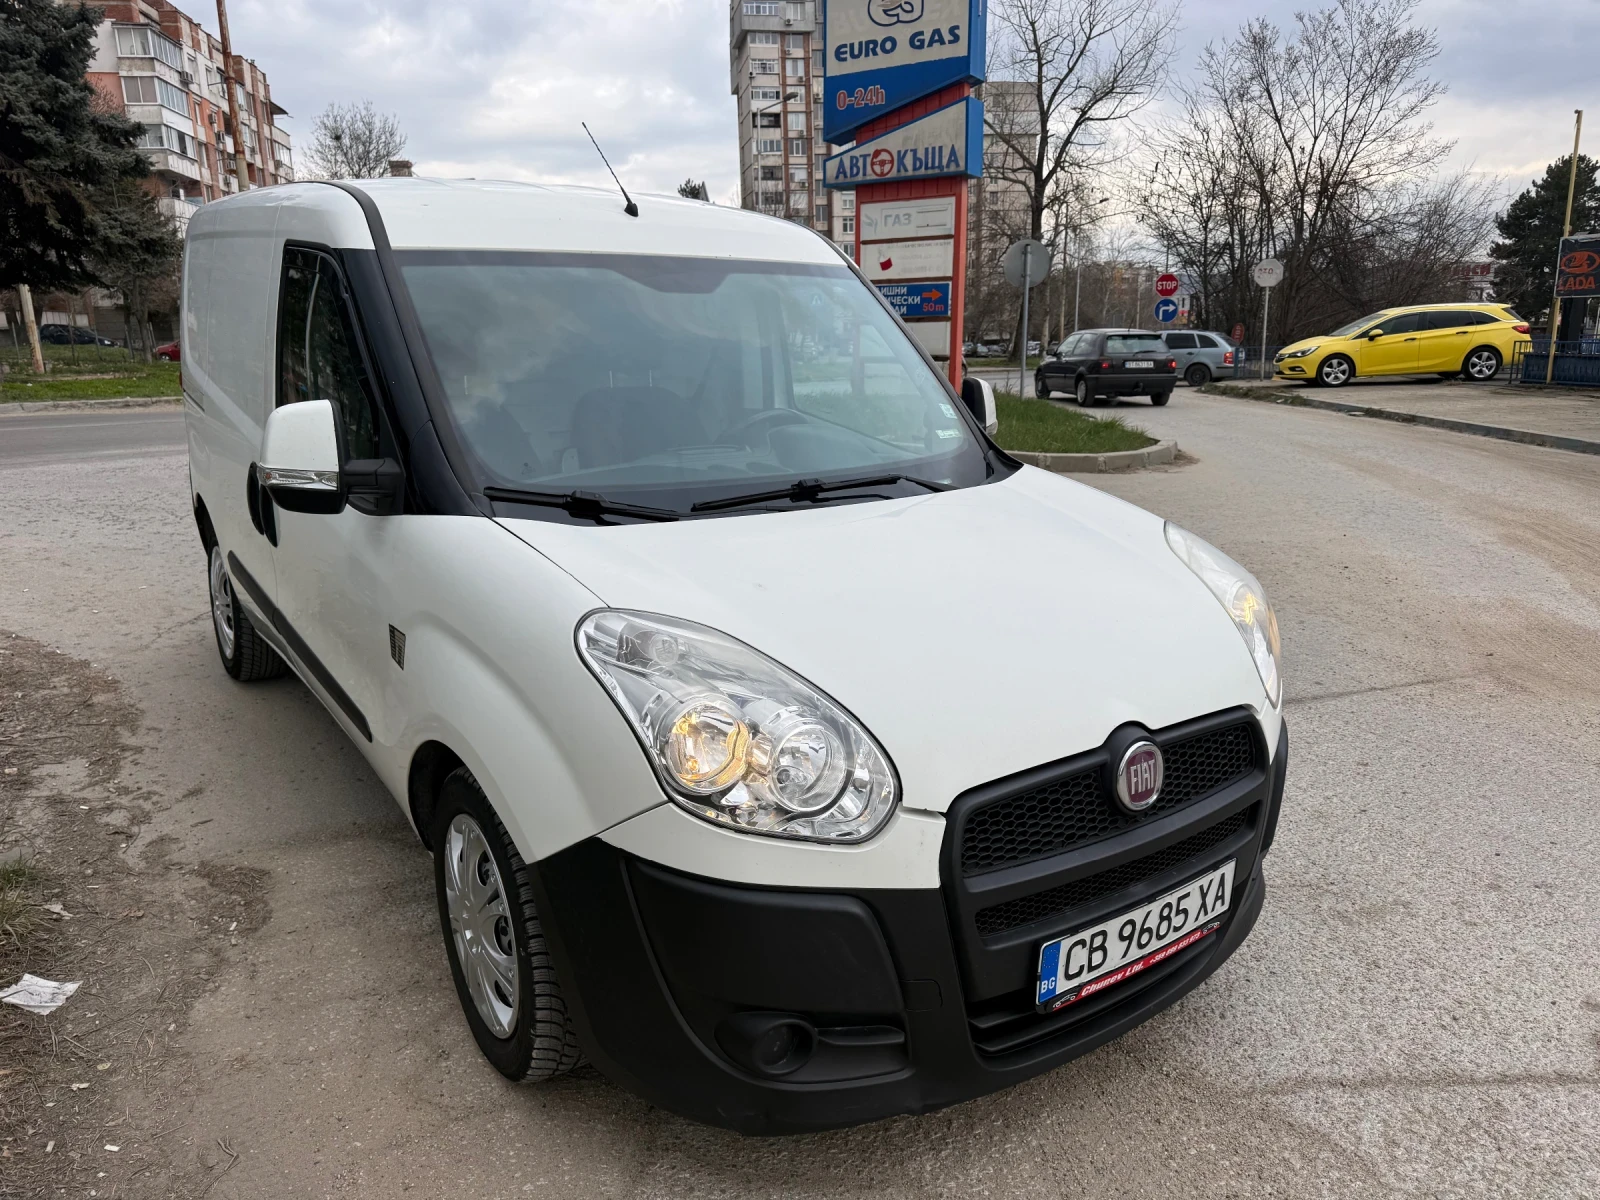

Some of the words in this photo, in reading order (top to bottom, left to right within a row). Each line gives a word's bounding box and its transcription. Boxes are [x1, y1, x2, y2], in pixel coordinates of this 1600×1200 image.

[909, 25, 960, 50] GAS
[836, 85, 885, 110] 0-24h
[884, 213, 912, 227] ГАЗ
[877, 286, 907, 295] ИШНИ
[1157, 281, 1177, 290] STOP
[1556, 276, 1596, 290] LADA
[922, 303, 935, 312] 50
[1130, 757, 1155, 795] FIAT
[1064, 929, 1108, 981] CB
[1118, 891, 1191, 960] 9685
[1194, 872, 1226, 923] XA
[1041, 977, 1056, 993] BG
